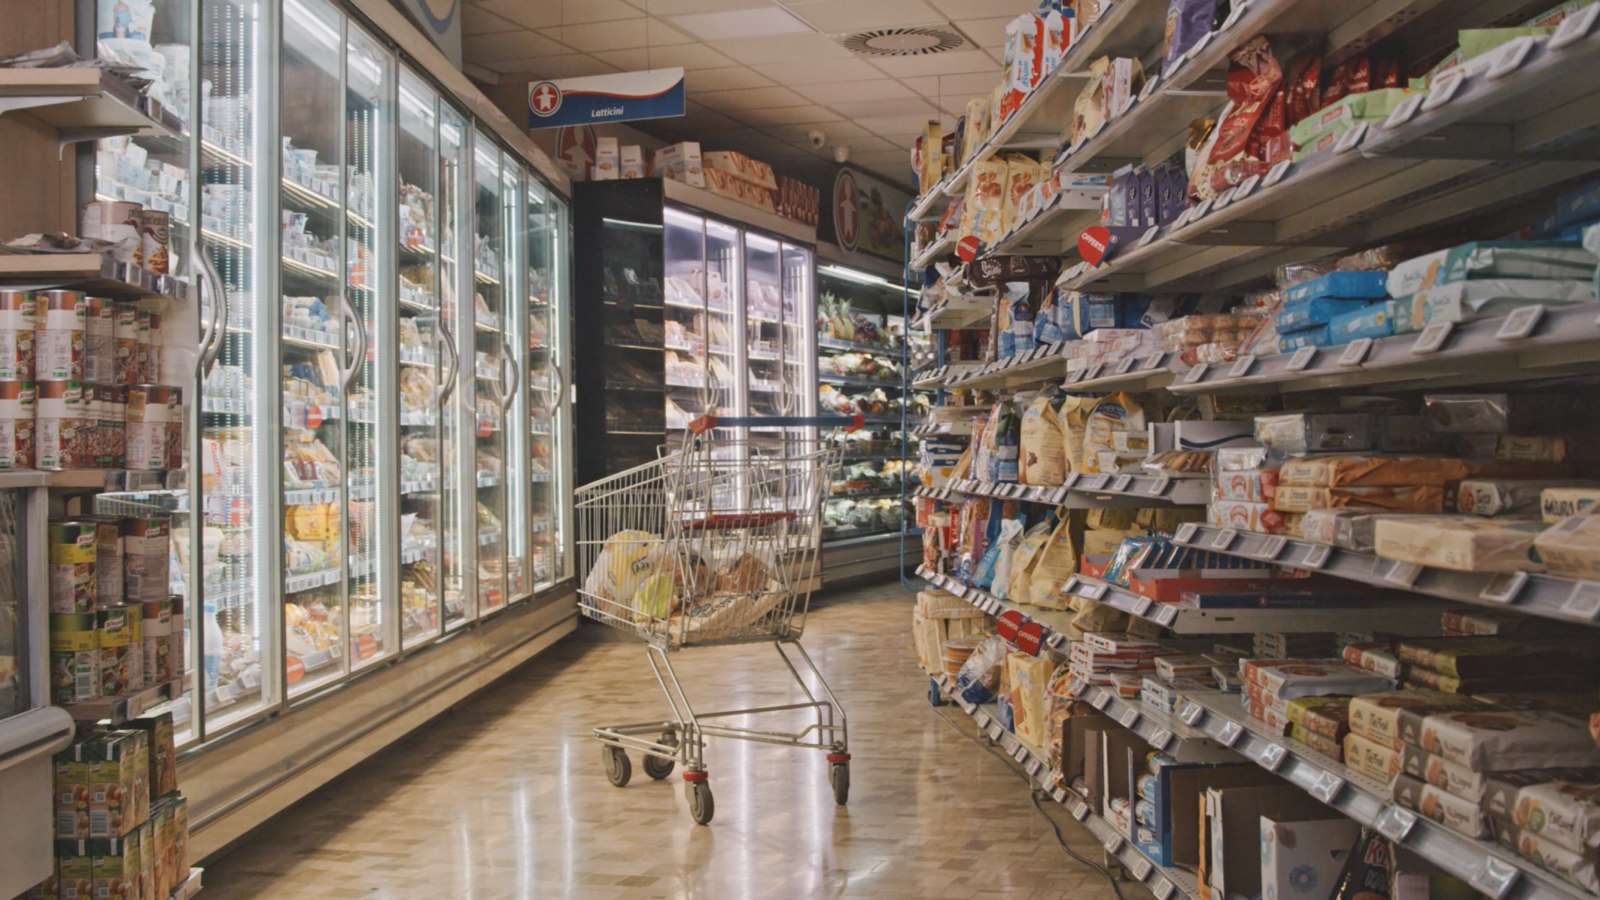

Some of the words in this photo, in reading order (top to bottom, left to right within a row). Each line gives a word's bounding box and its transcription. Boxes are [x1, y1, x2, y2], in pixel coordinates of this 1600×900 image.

[591, 106, 624, 118] Latticini
[958, 241, 977, 254] OFFERTA
[1081, 232, 1106, 253] OFFERTA
[999, 616, 1019, 632] OFFERTA
[1018, 630, 1040, 645] OFFERTA
